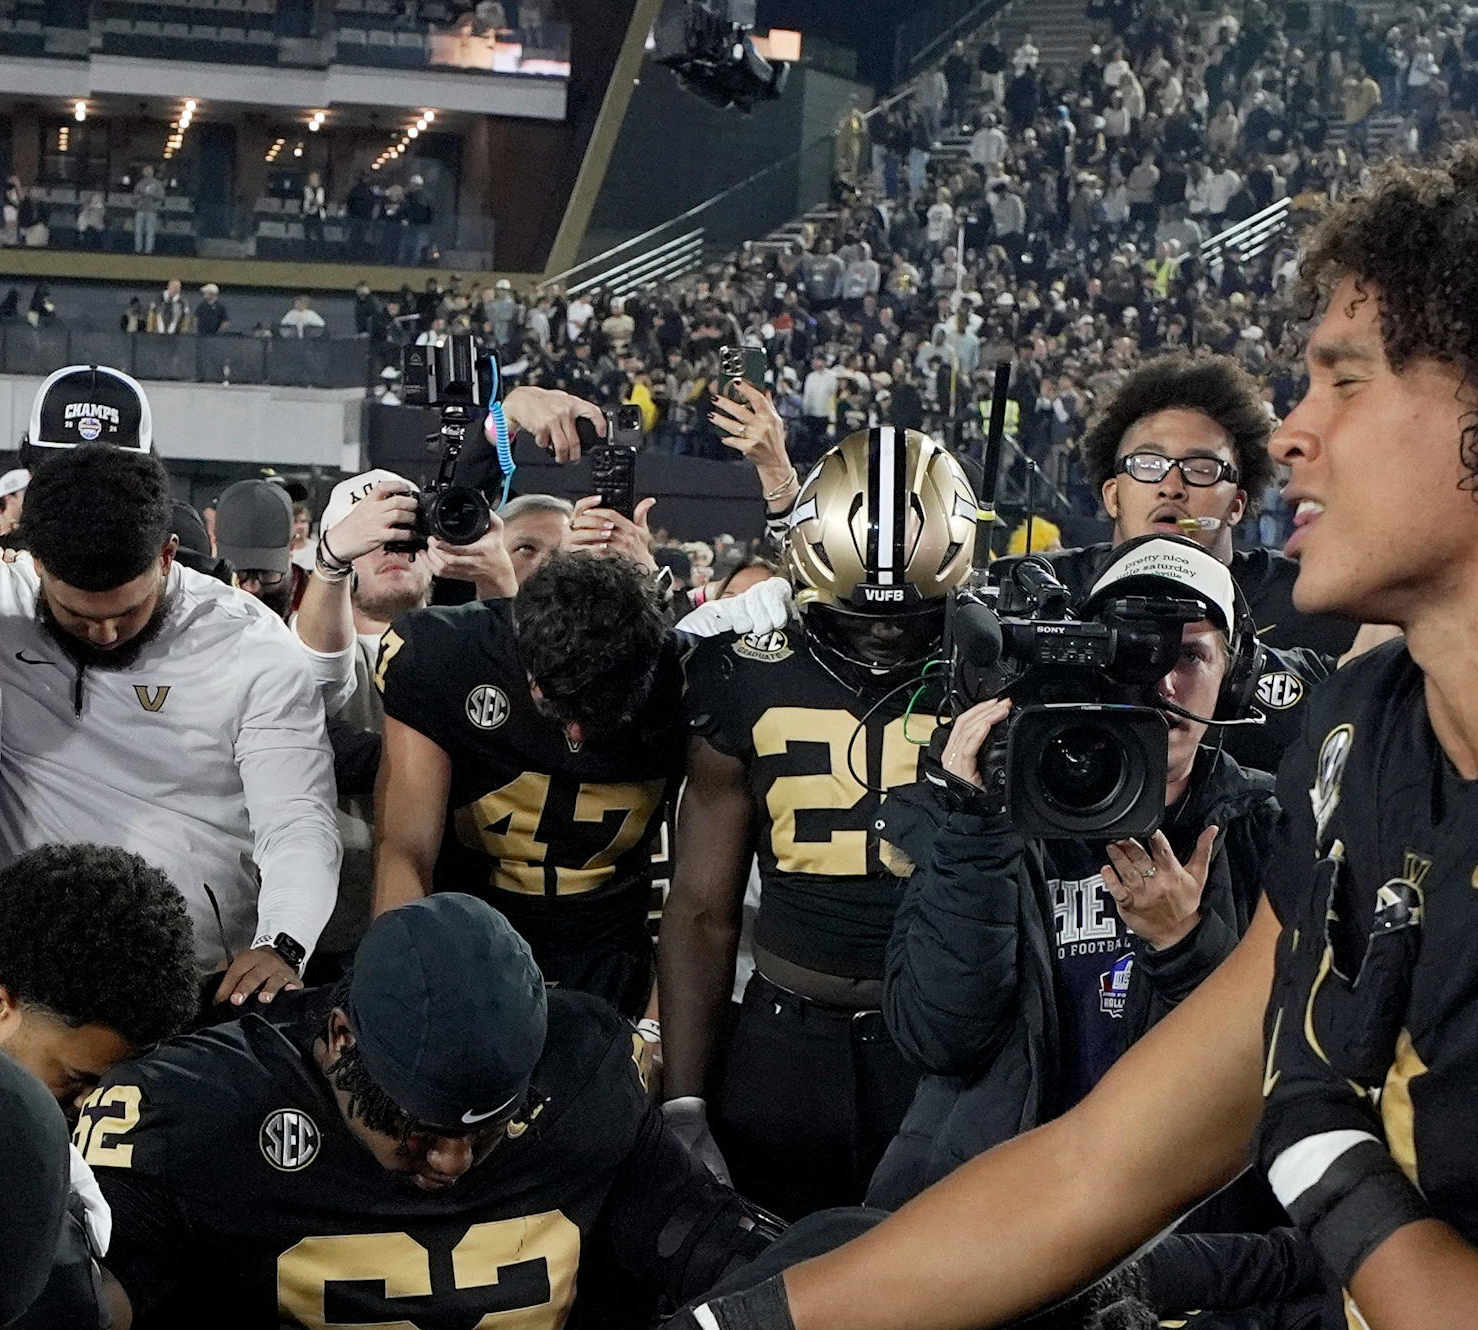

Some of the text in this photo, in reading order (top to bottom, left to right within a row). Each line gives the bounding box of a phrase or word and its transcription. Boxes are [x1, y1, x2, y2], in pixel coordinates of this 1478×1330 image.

[64, 402, 119, 425] CHAMPS
[1124, 553, 1190, 571] pretty nice
[1142, 563, 1198, 579] saturday
[865, 588, 904, 602] VUFB
[1036, 626, 1066, 634] SONY
[745, 631, 784, 651] SEC
[737, 646, 783, 661] GRADUATE
[132, 685, 171, 713] V
[1258, 676, 1301, 706] SEC
[469, 688, 507, 726] SEC
[455, 770, 667, 896] 47
[1069, 938, 1132, 957] FOOTBAL
[71, 1084, 142, 1169] 62
[265, 1112, 317, 1169] SEC
